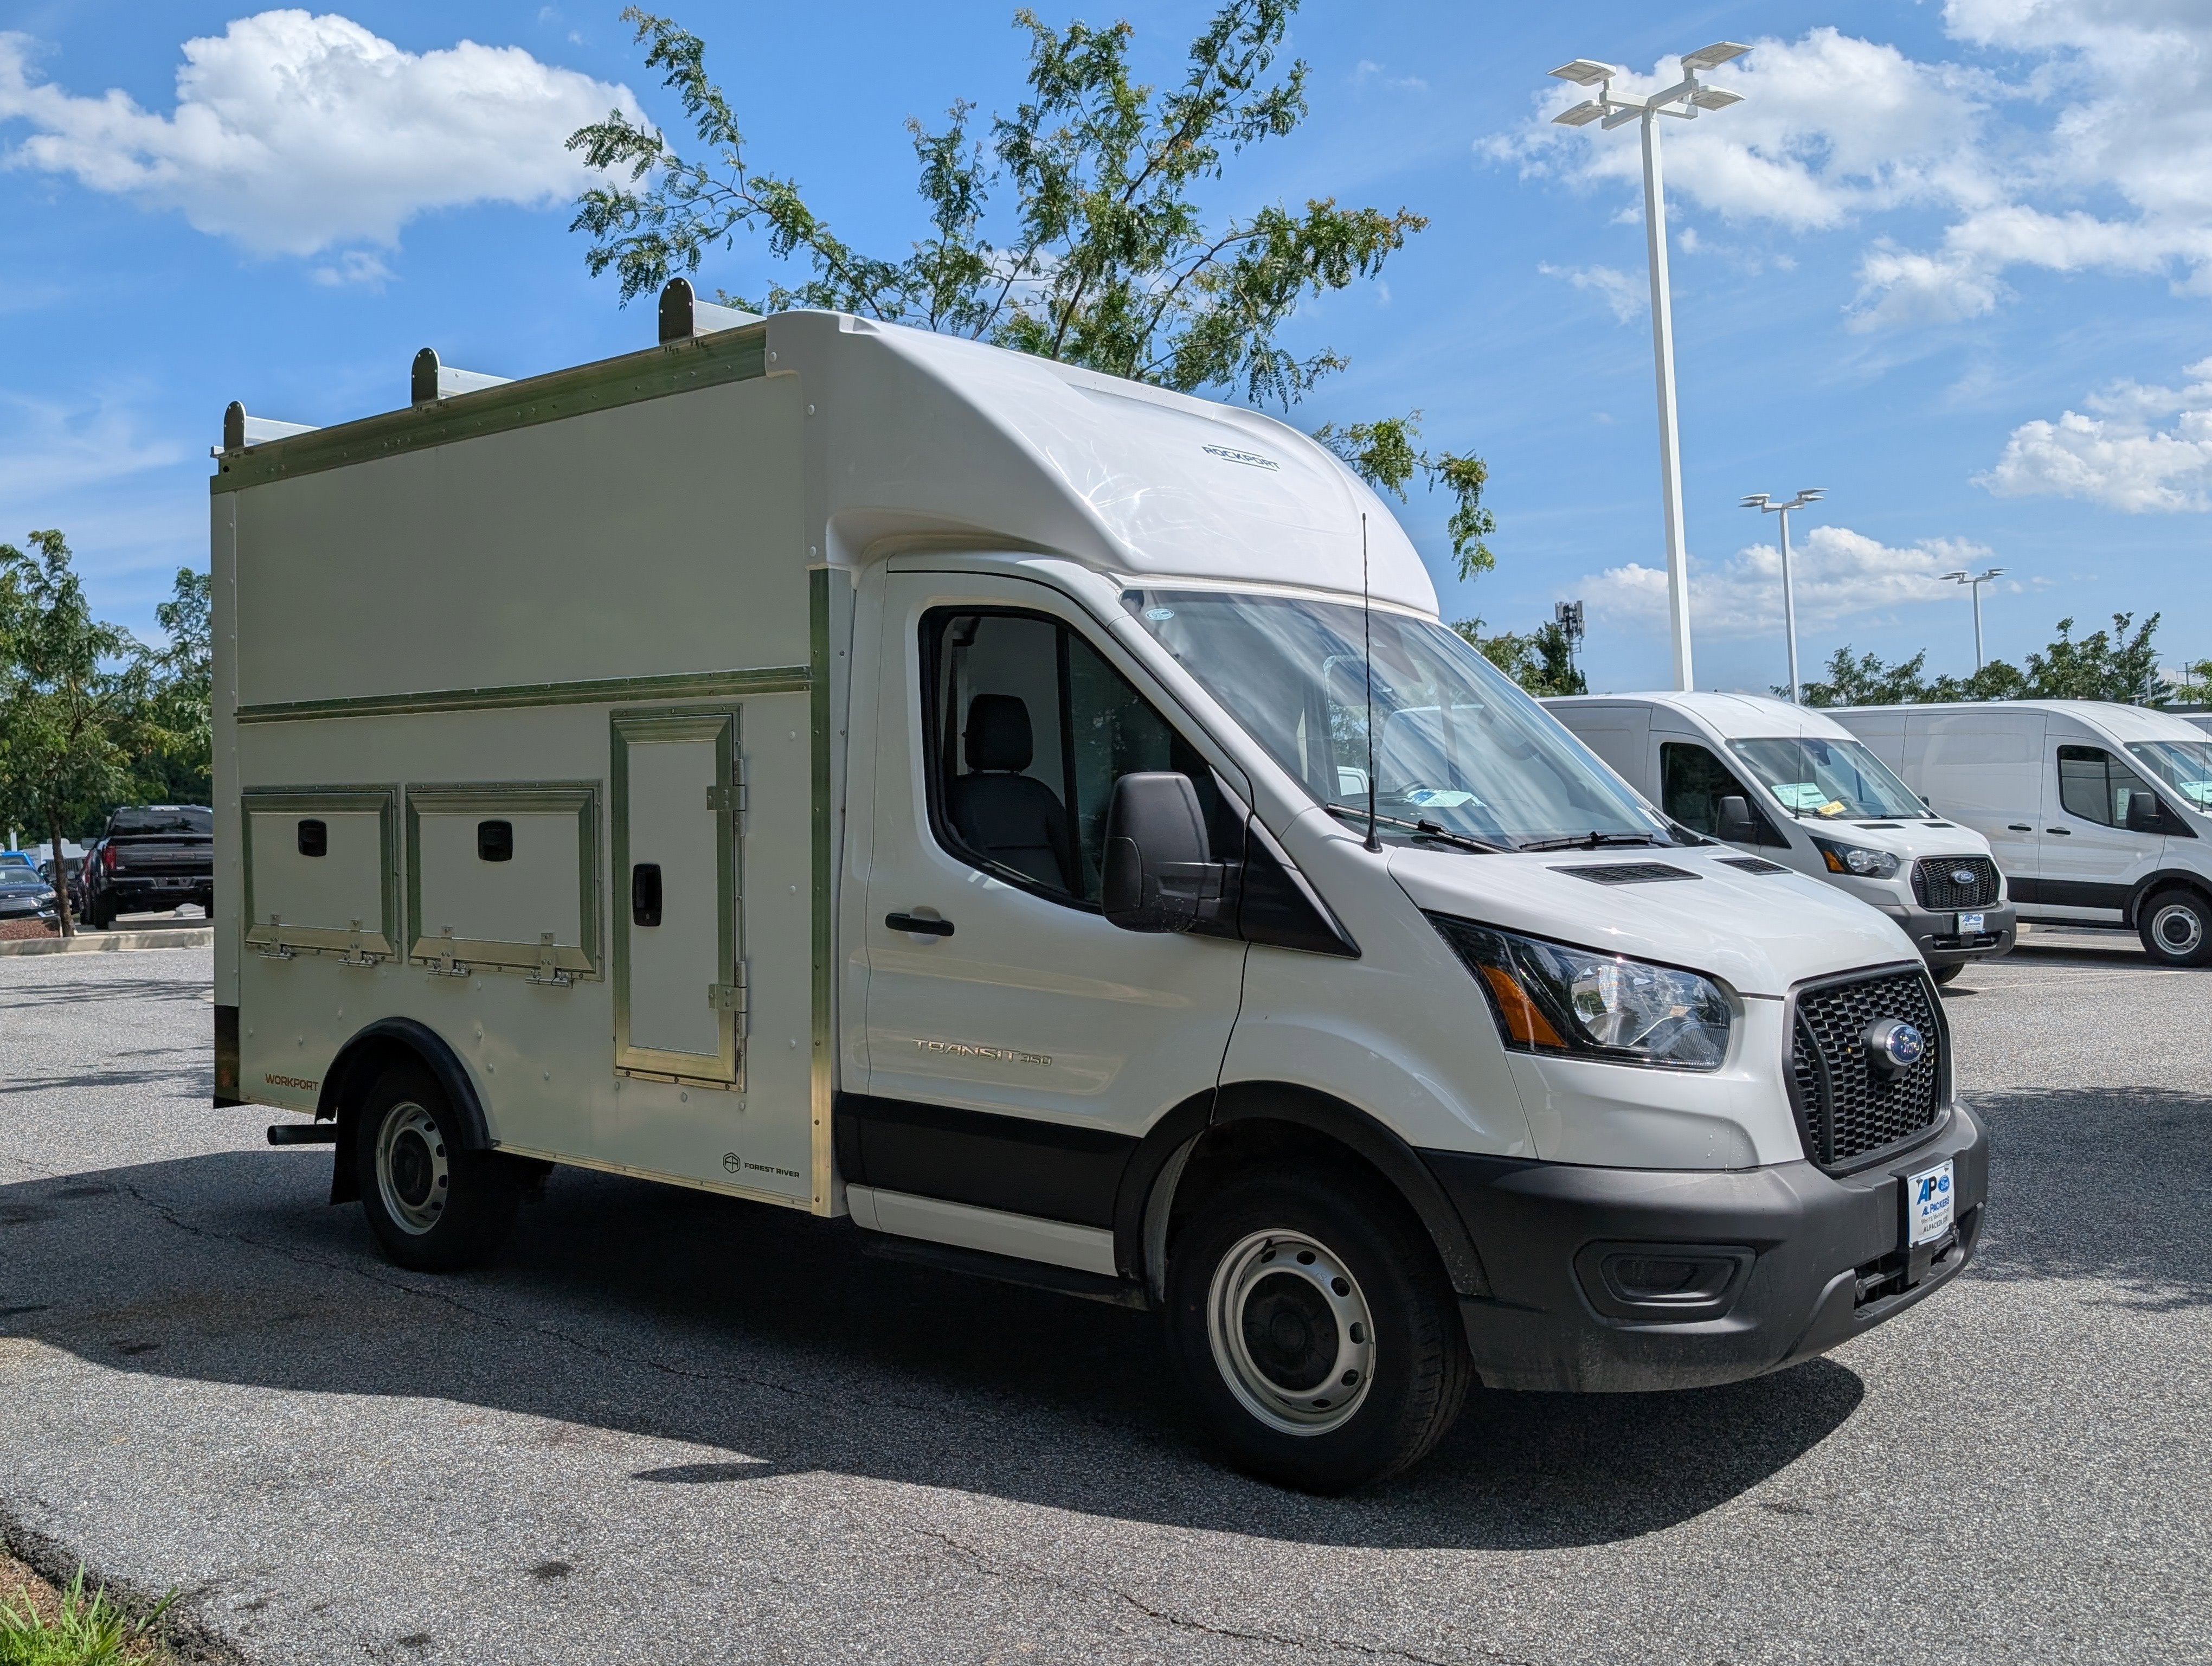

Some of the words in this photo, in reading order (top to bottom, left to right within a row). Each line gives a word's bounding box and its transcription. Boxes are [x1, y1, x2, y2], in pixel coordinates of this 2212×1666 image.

[1200, 446, 1281, 470] ROCKPORT
[912, 1038, 1020, 1062] TRANSIT
[1020, 1053, 1052, 1066] 350
[265, 1073, 319, 1091] WORKPORT
[744, 1162, 775, 1173] FOREST
[776, 1168, 800, 1178] RIVER
[1917, 1175, 1937, 1206] AP
[1921, 1204, 1930, 1217] AL
